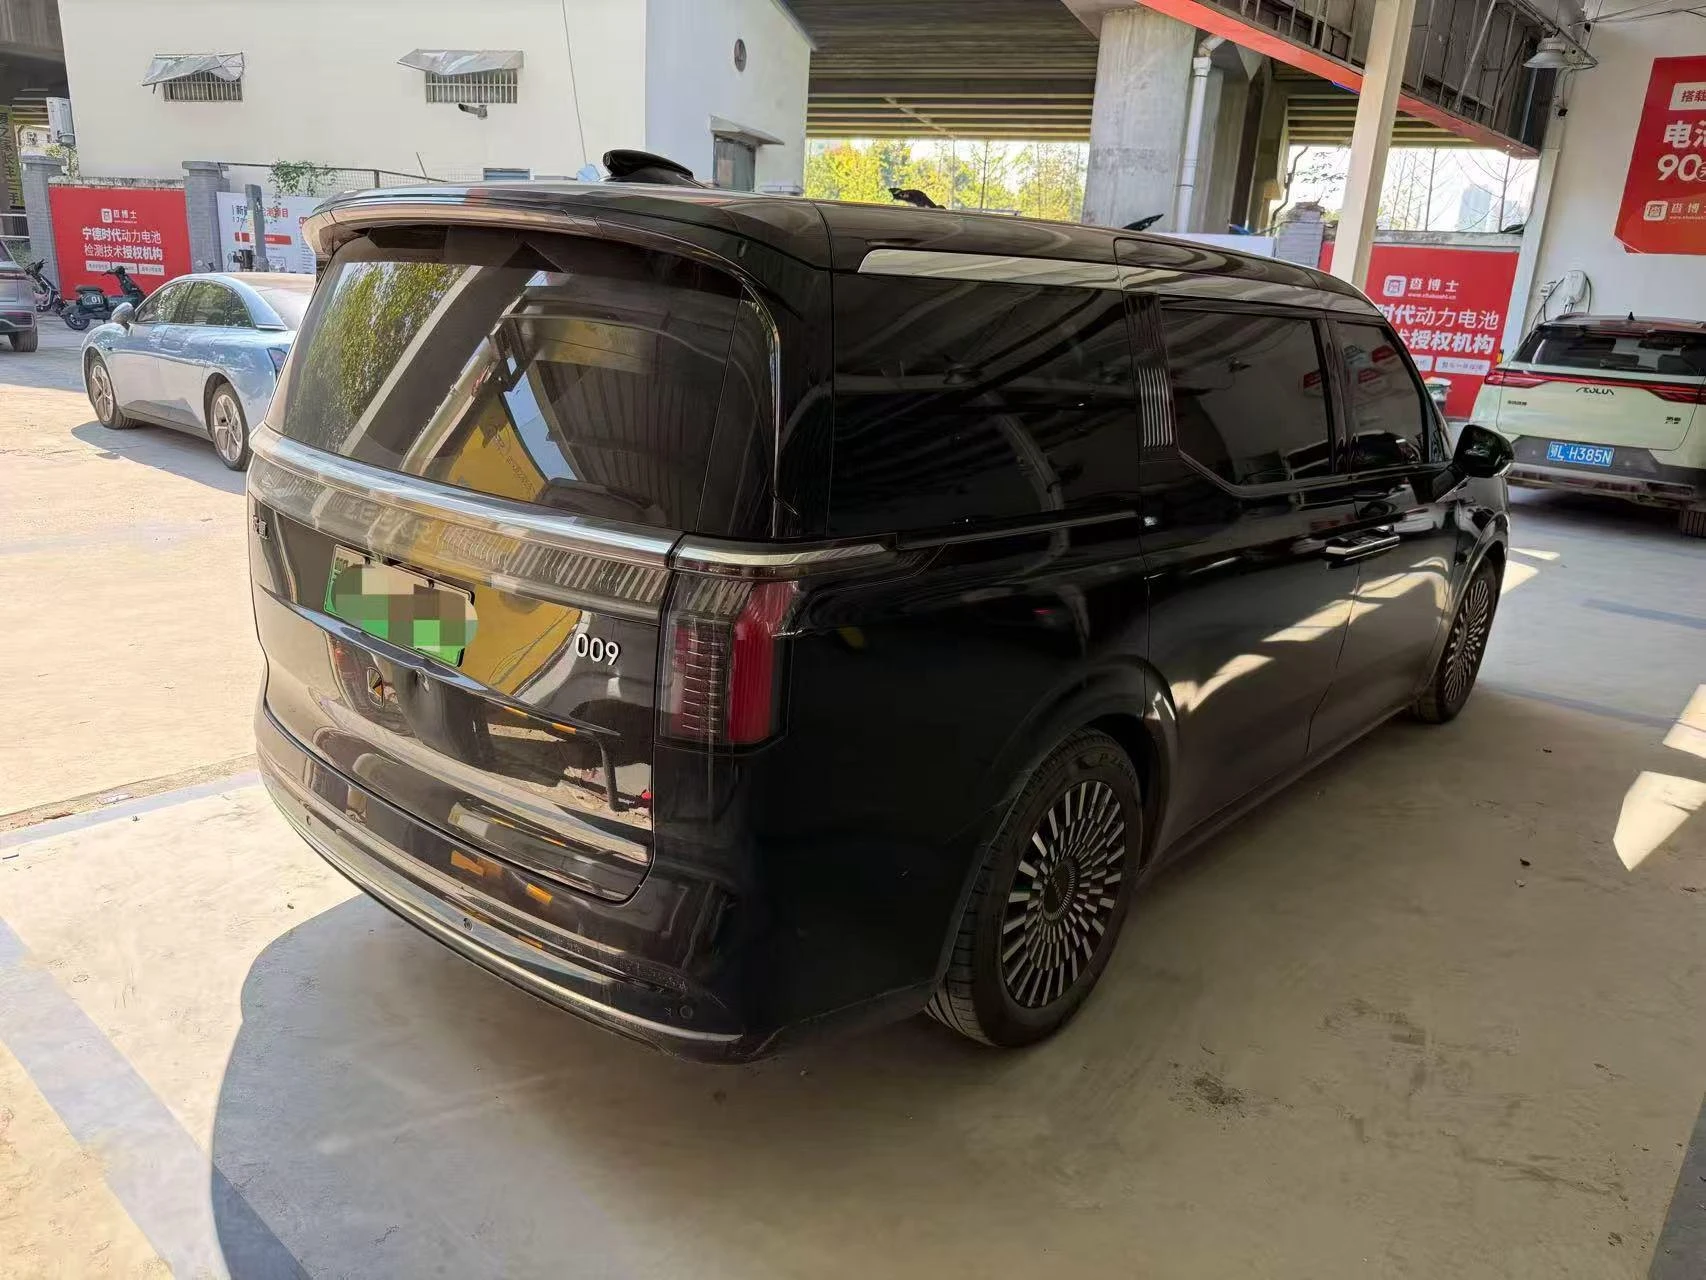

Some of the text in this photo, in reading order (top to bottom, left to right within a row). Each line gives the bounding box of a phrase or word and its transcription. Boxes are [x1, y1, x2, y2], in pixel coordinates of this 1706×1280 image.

[1671, 202, 1706, 214] 查博
[82, 227, 162, 244] 宁德时代动力电池
[84, 243, 163, 261] 检测技术授权机构
[1409, 277, 1459, 293] 查博士
[575, 633, 619, 666] 009
